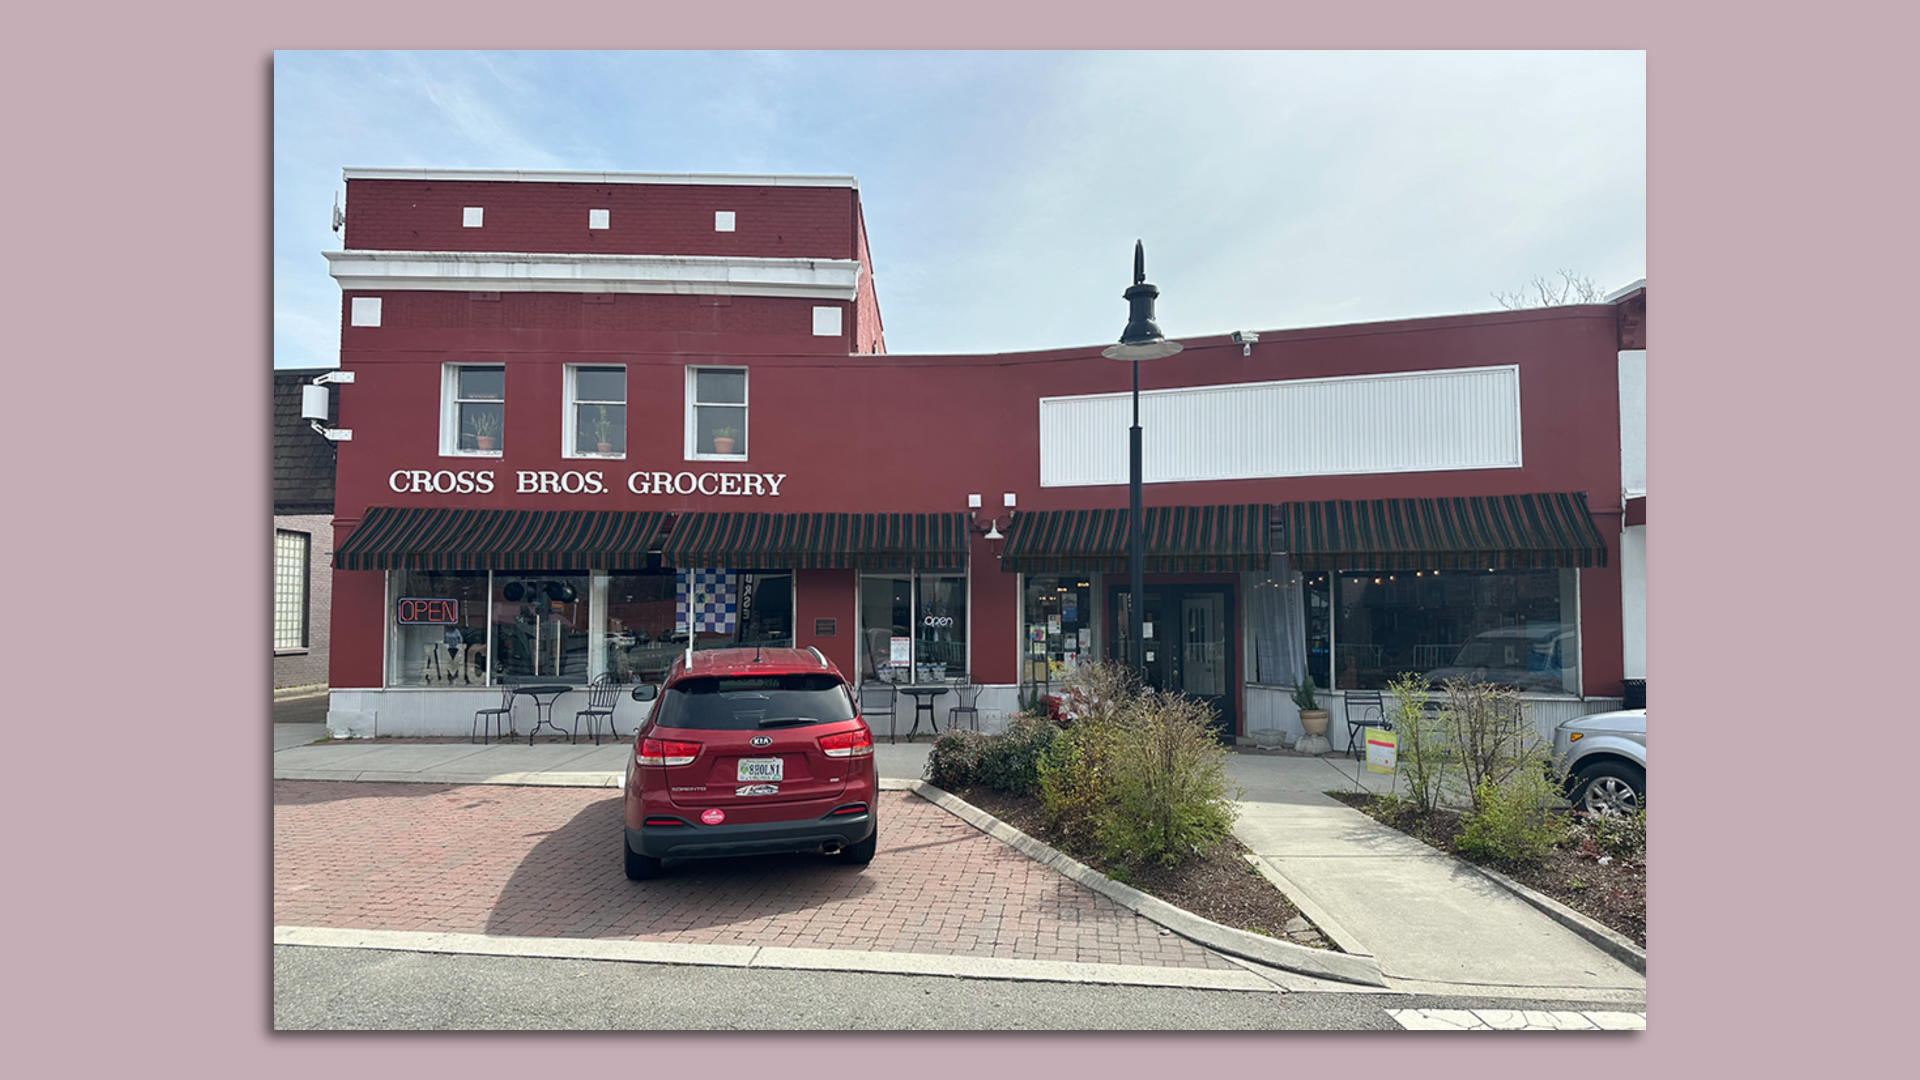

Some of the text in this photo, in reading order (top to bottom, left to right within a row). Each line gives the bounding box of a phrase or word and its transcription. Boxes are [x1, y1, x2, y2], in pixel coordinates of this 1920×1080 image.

[389, 470, 786, 497] CROSS BROS. GROCERY
[400, 600, 457, 622] OPEN
[924, 615, 953, 628] open
